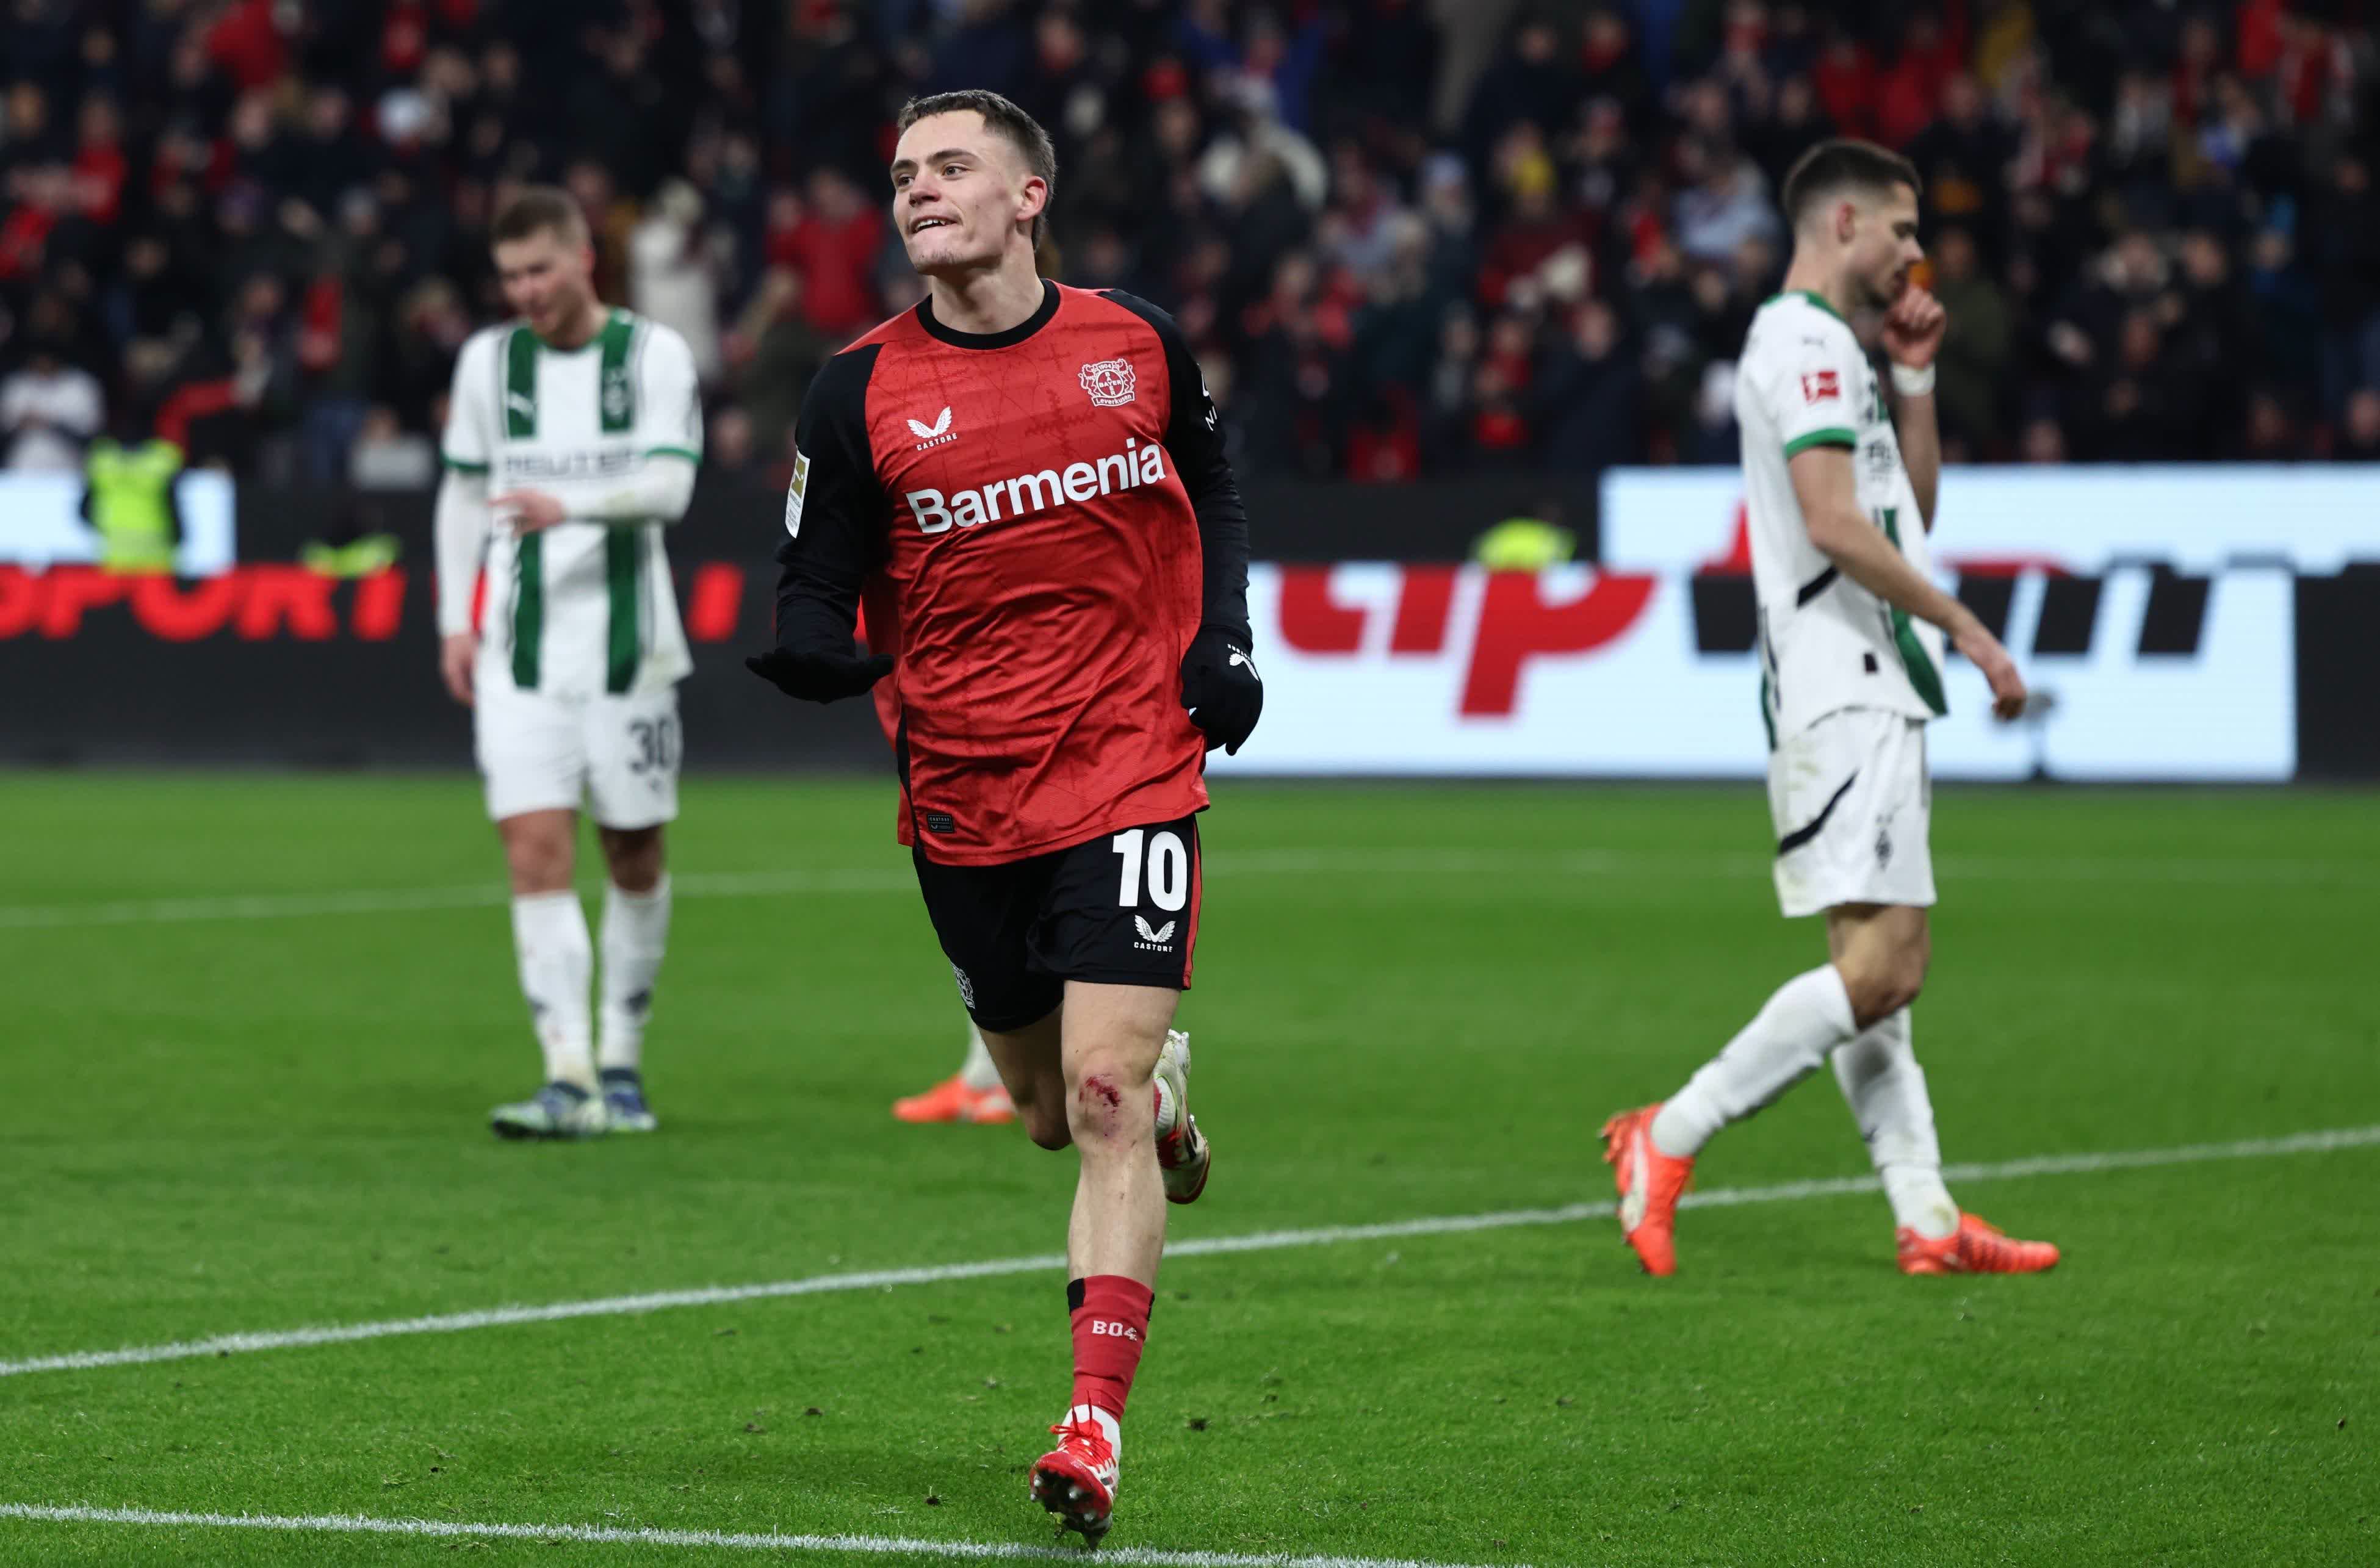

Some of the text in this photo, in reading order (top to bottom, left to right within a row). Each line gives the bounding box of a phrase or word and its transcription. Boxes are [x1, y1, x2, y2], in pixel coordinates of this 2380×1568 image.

[1098, 379, 1122, 388] BAYER
[1095, 394, 1131, 405] Leverkusen
[917, 433, 957, 451] CASTORE
[906, 437, 1166, 533] Barmenia
[1112, 829, 1187, 911] 10
[1134, 941, 1172, 952] CASTORE
